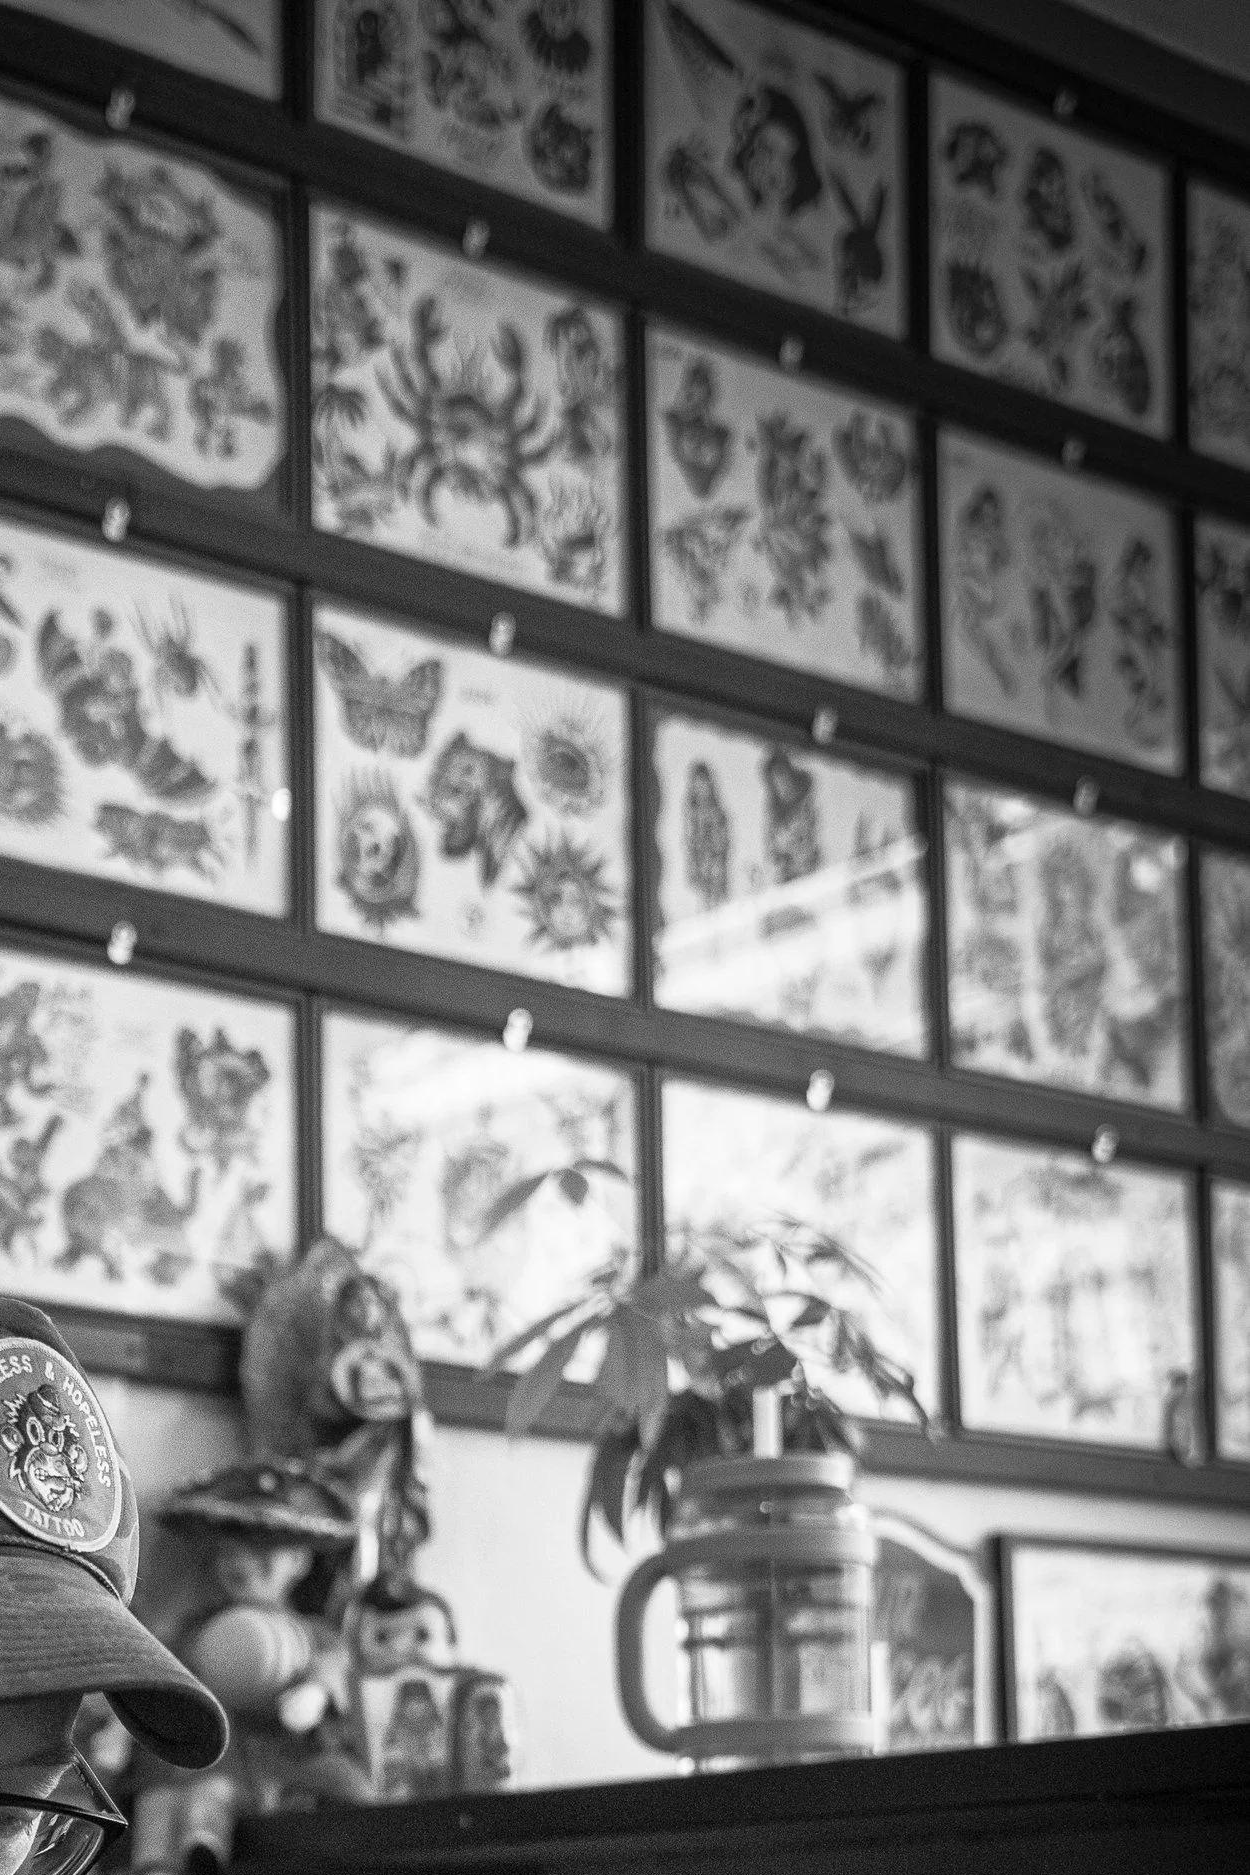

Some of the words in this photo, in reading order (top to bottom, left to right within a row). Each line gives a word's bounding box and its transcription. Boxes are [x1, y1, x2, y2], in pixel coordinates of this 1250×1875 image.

[44, 1361, 55, 1381] &
[62, 1375, 112, 1488] HOPELESS
[23, 1500, 85, 1538] TATTOO
